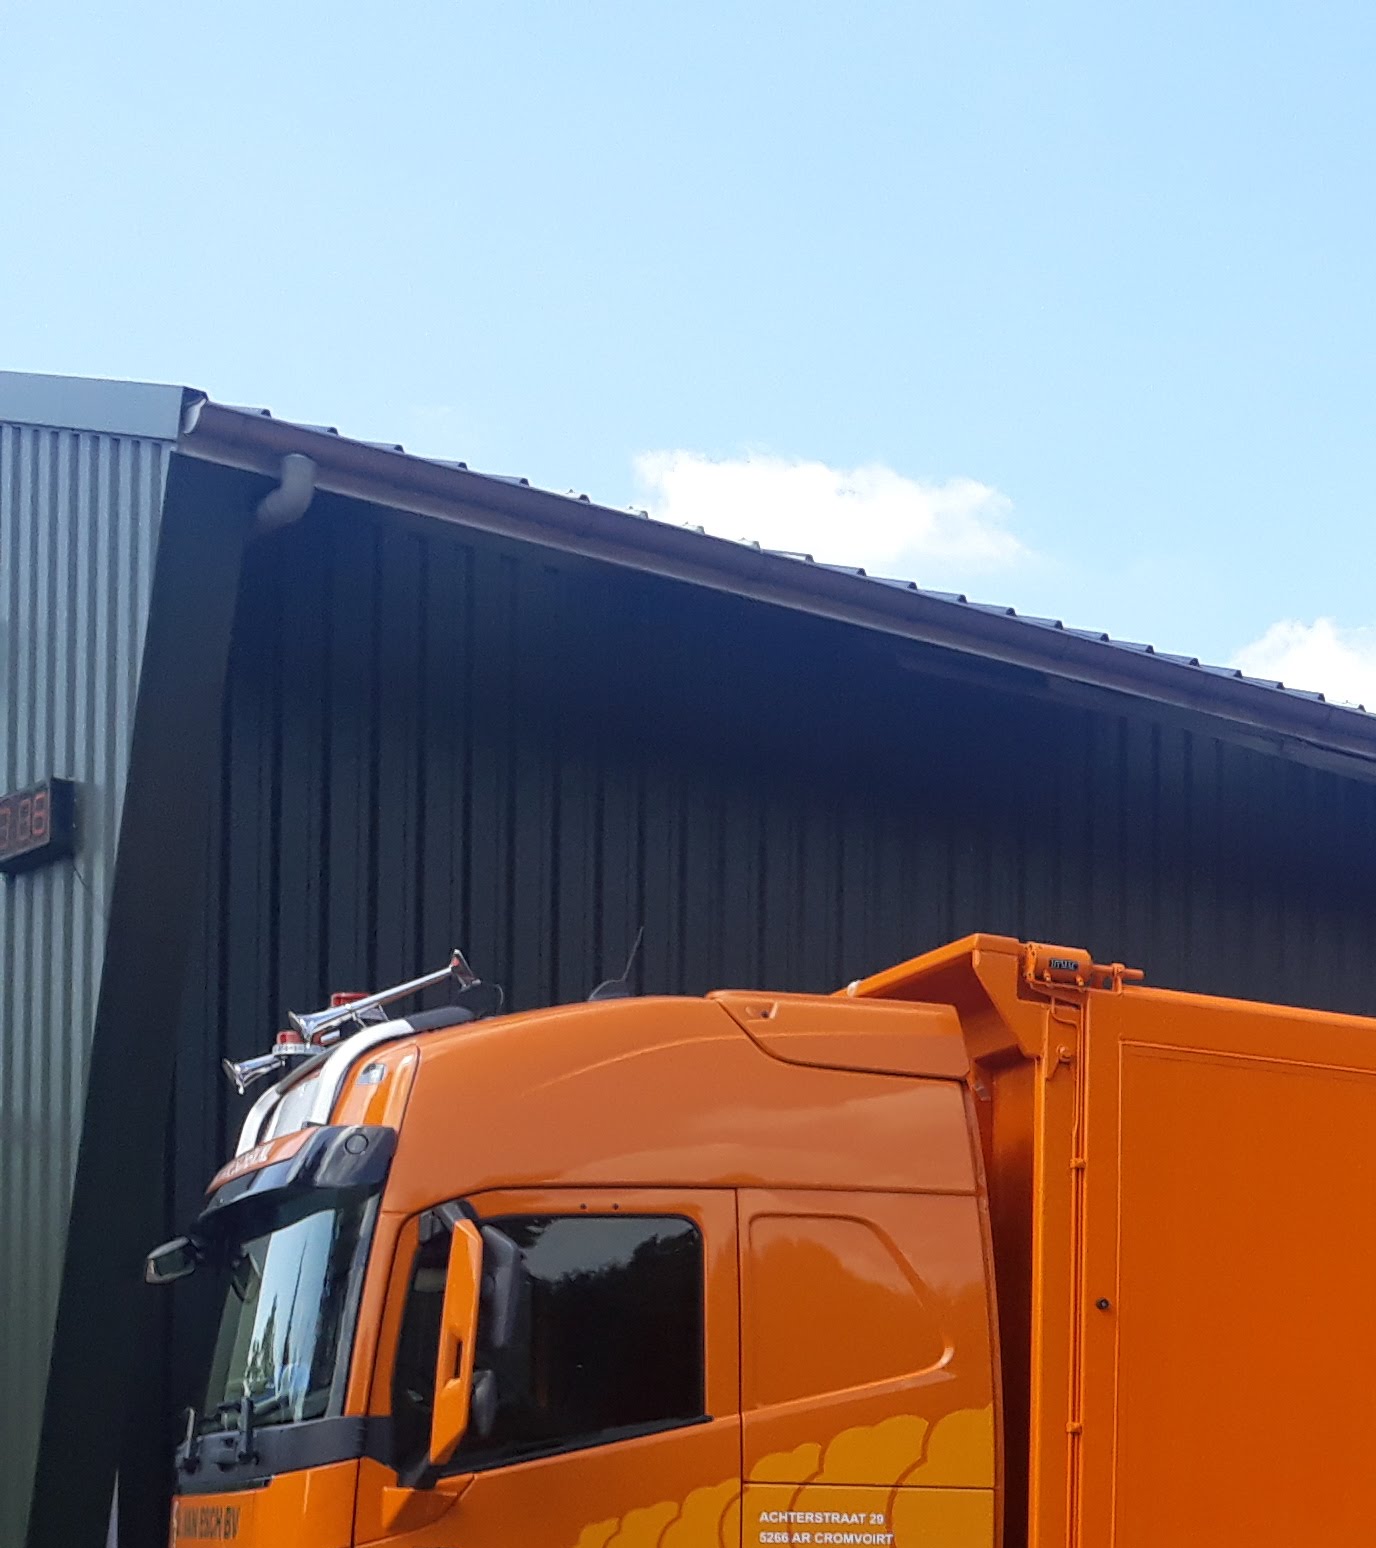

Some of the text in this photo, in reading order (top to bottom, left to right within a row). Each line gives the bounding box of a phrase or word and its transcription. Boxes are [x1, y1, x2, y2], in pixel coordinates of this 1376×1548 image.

[759, 1511, 866, 1524] ACHTERSTRAAT
[759, 1532, 894, 1545] 5266 AR CROMVOIRT
